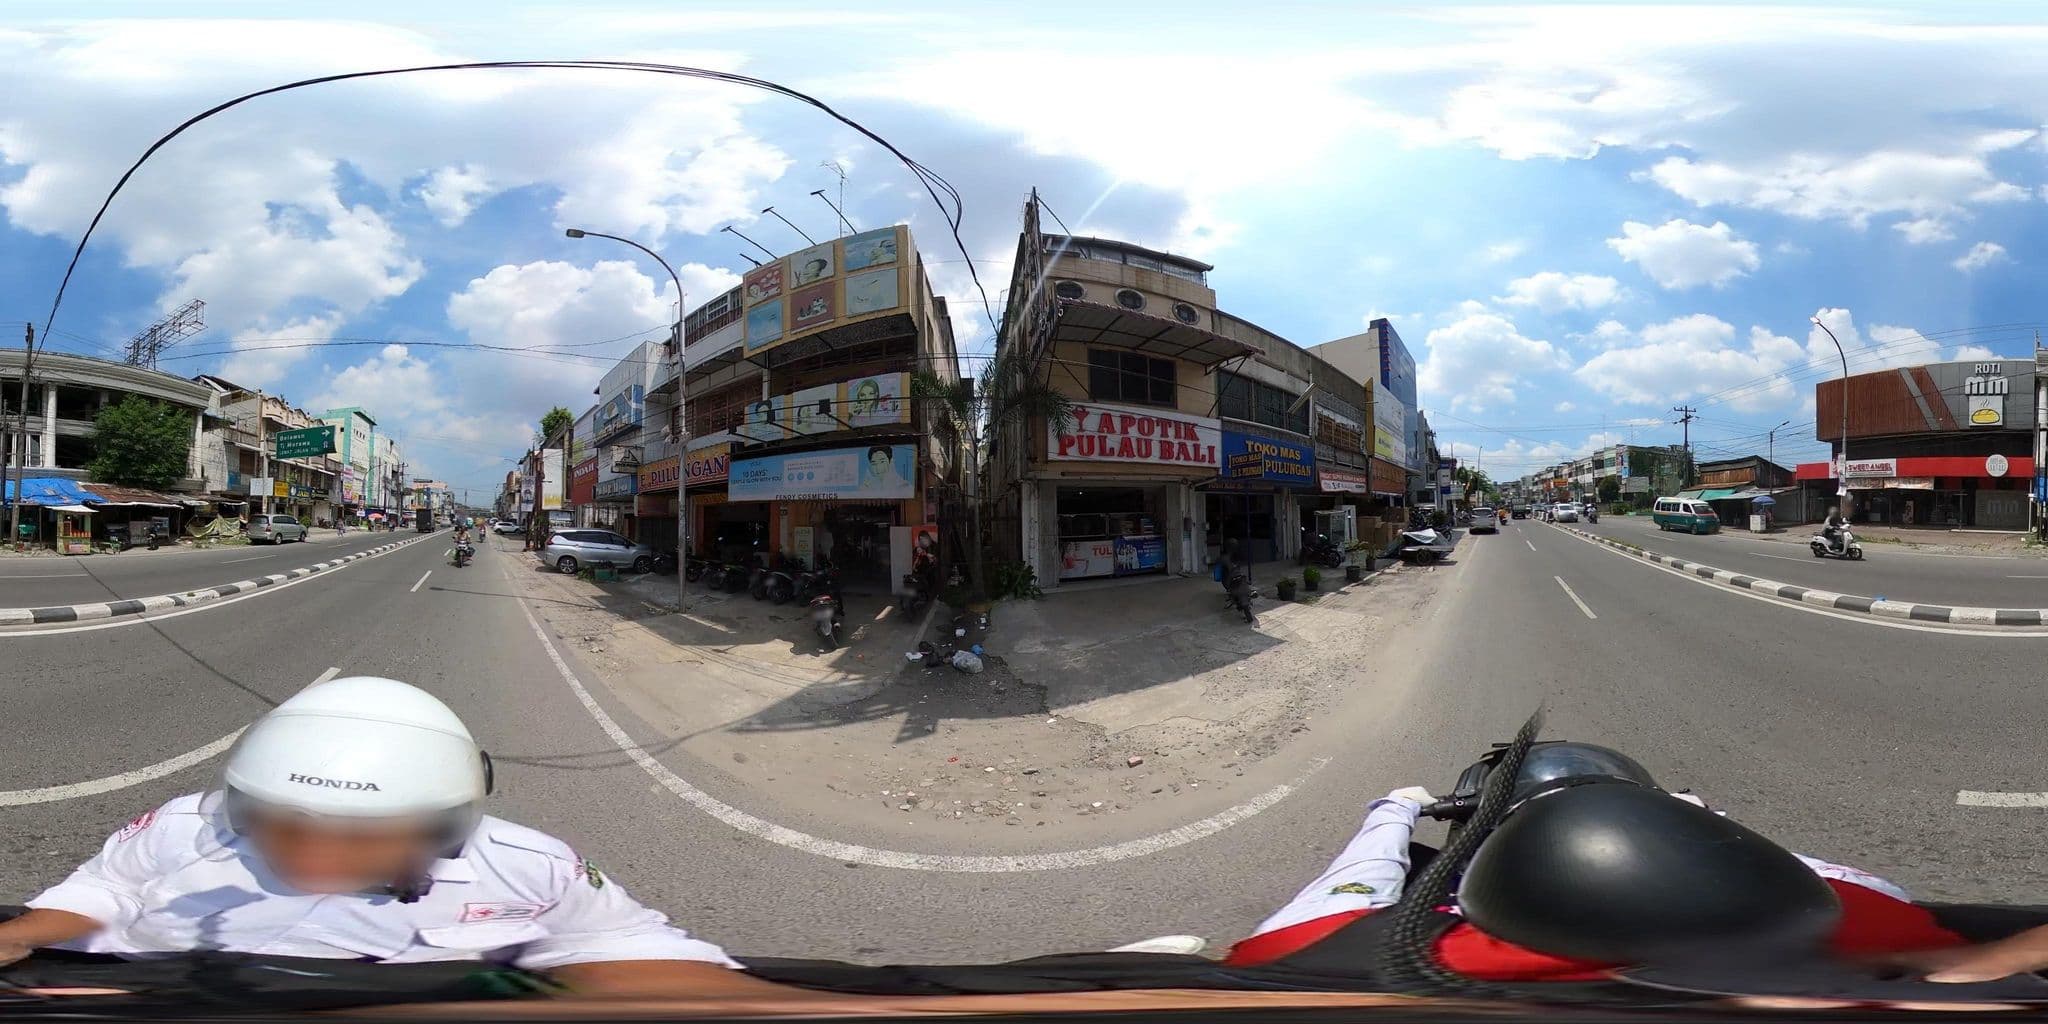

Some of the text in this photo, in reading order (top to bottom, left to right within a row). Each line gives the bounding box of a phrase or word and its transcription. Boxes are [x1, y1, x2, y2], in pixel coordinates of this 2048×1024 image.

[1975, 363, 2001, 374] ROTI
[1097, 412, 1200, 441] APOTIK
[1057, 434, 1217, 464] PULAU BALI
[1245, 440, 1301, 460] TOKO MAS
[1264, 459, 1312, 477] PULUNGAN
[798, 492, 839, 501] COSMETICS
[288, 773, 381, 792] HONDA
